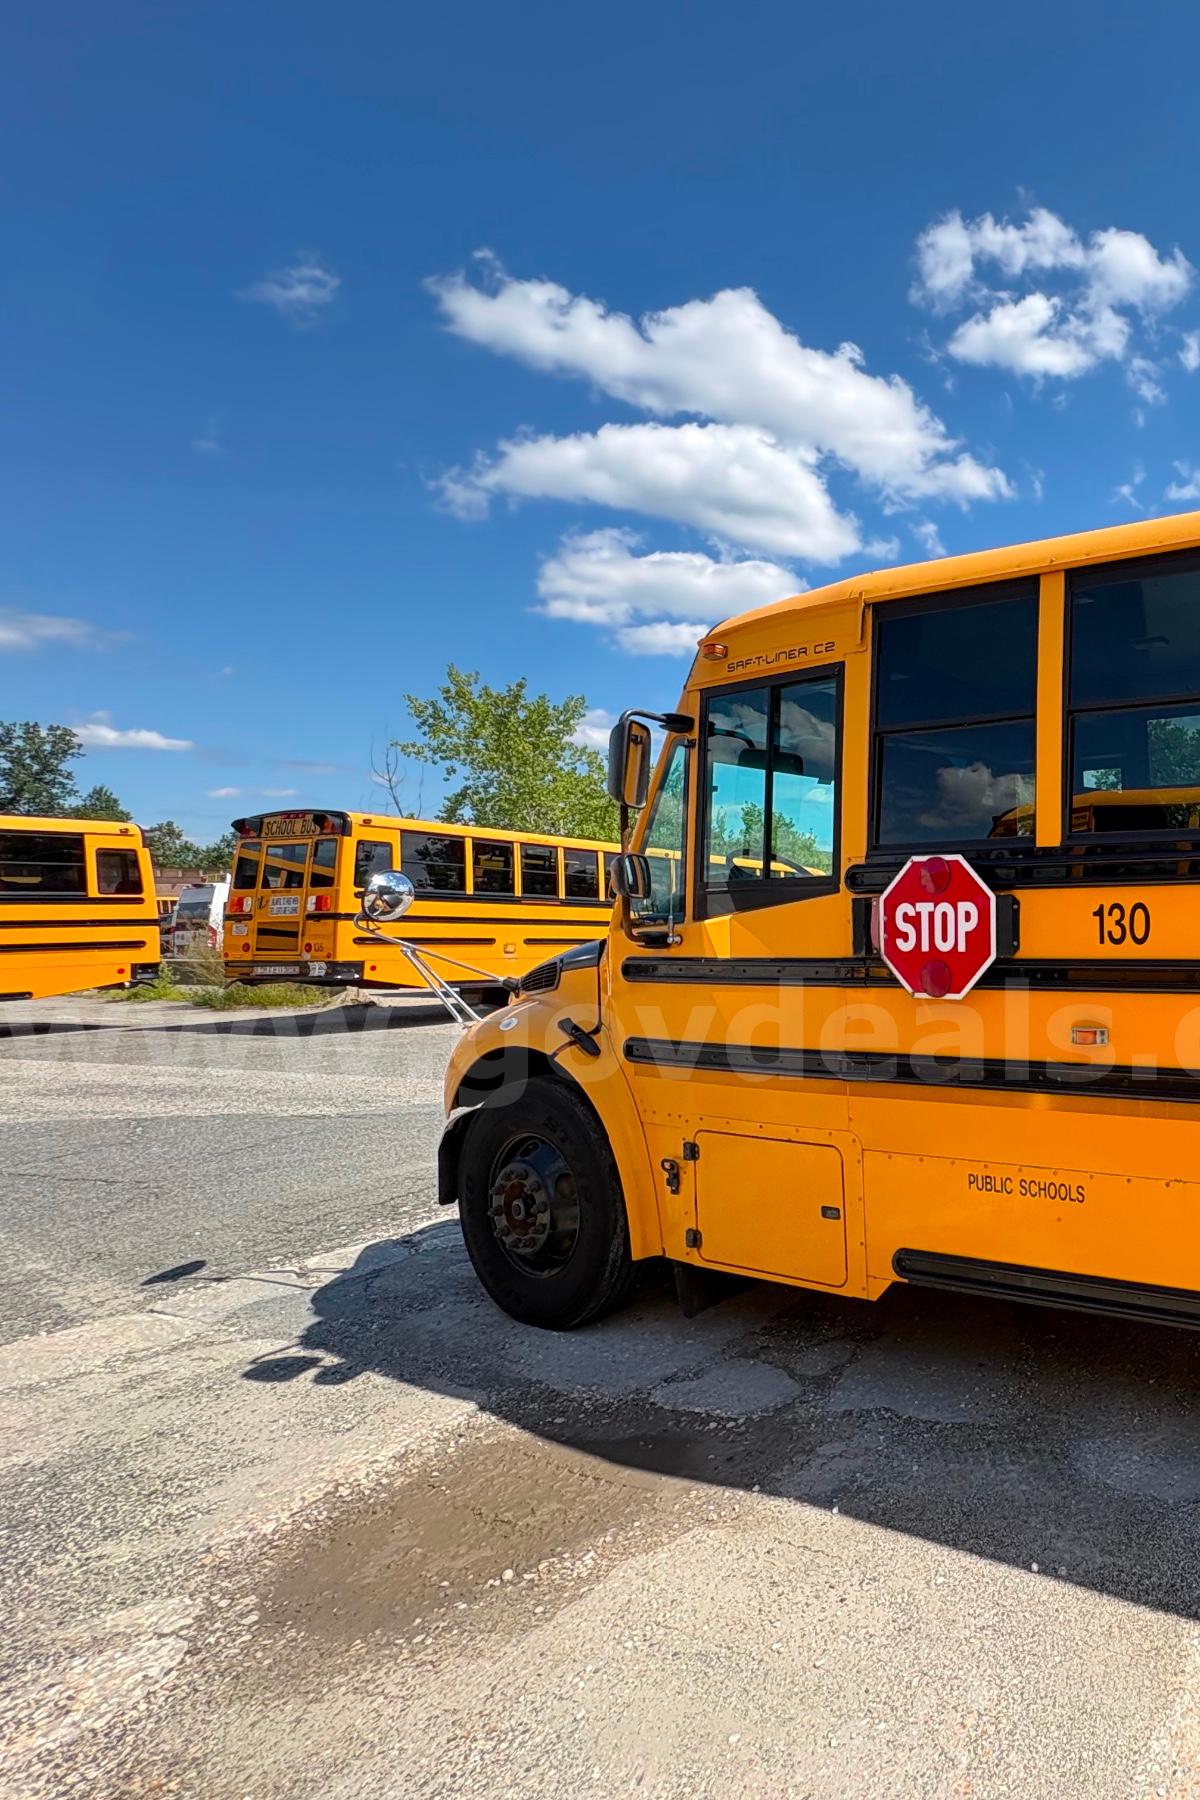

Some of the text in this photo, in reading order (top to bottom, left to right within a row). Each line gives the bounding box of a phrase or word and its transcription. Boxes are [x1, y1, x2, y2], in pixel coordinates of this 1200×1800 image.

[814, 641, 836, 654] C2
[265, 818, 317, 836] SCHOOL BUS
[895, 901, 979, 952] STOP
[1092, 902, 1151, 945] 130
[968, 1173, 1085, 1203] PUBLIC SCHOOLS
